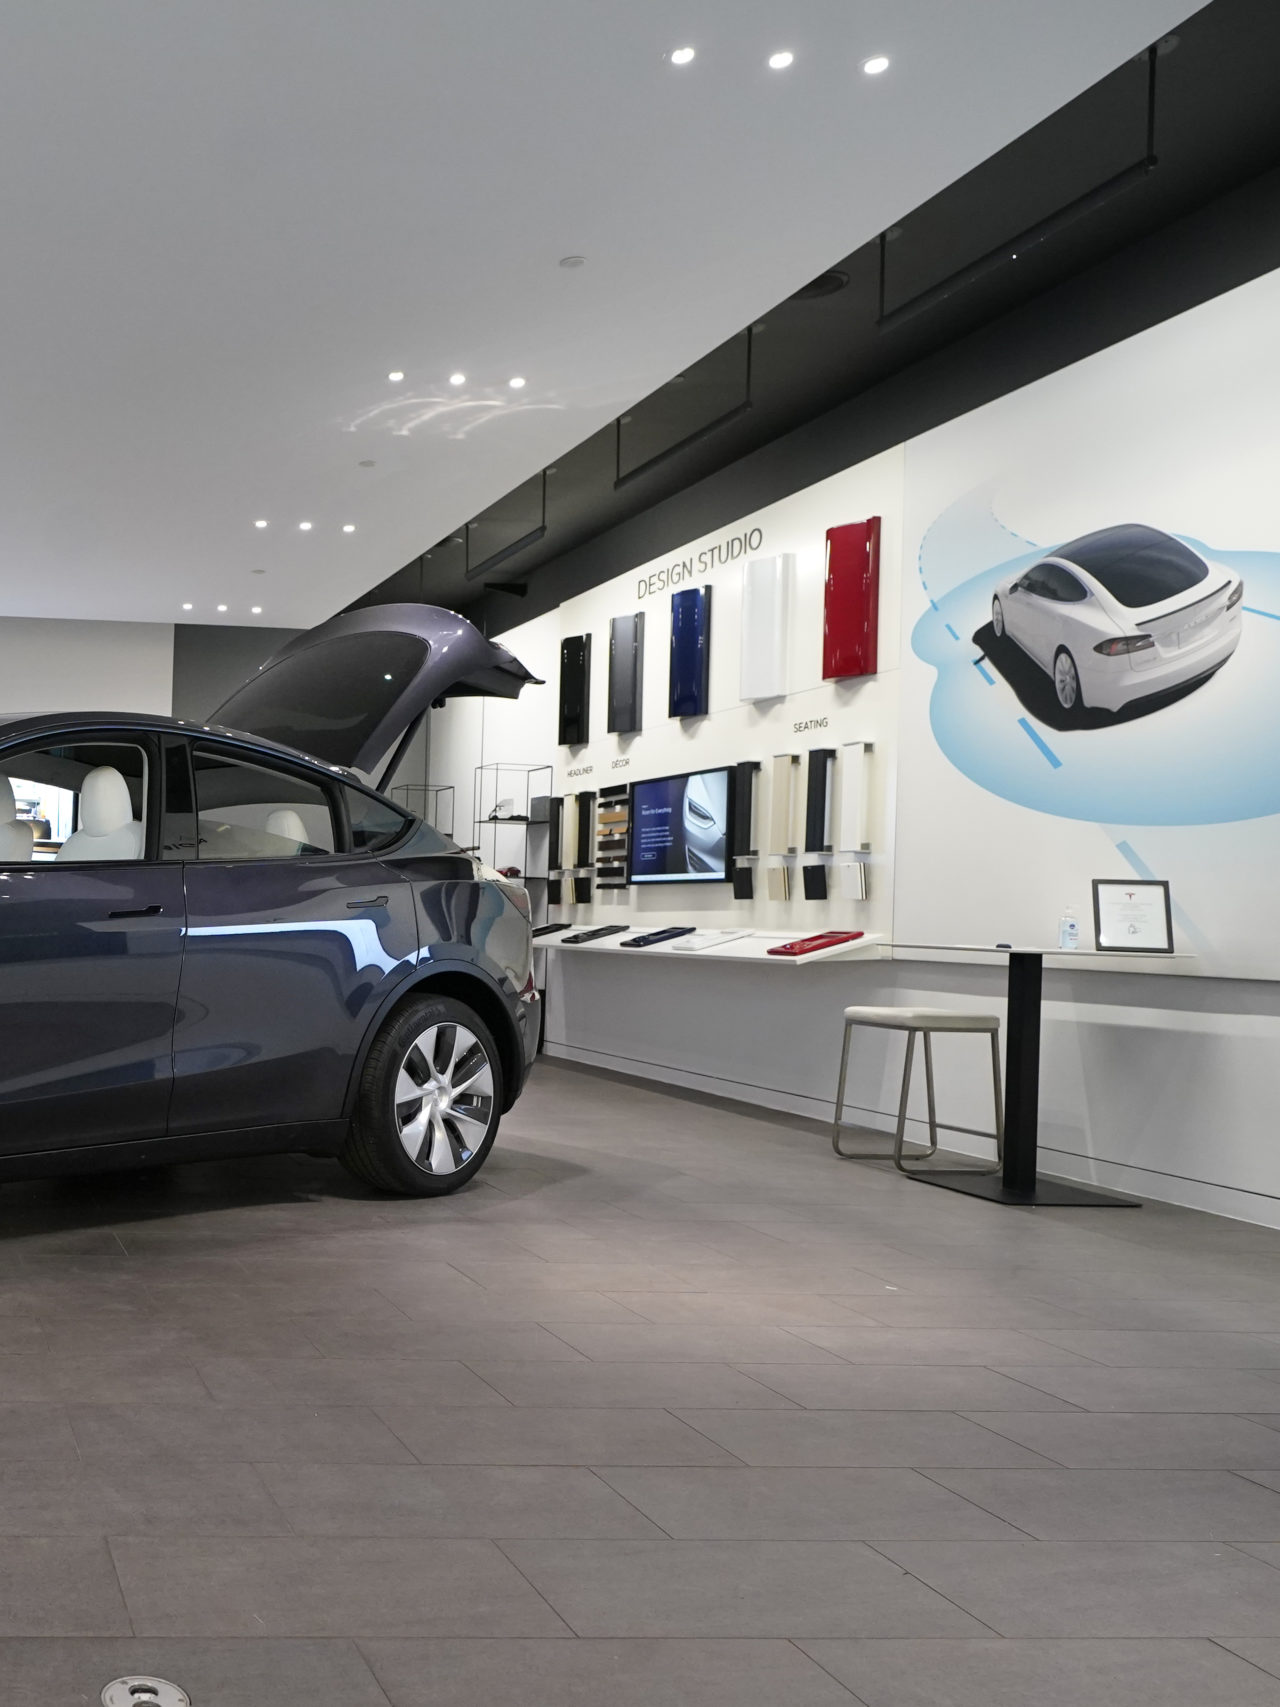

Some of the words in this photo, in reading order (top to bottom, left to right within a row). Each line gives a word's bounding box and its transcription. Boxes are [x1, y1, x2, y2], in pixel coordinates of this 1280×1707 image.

[637, 557, 694, 600] DESIGN
[697, 527, 763, 574] STUDIO
[793, 717, 829, 734] SEATING
[611, 757, 630, 770] DÉCOR
[567, 765, 593, 778] HEADLINER
